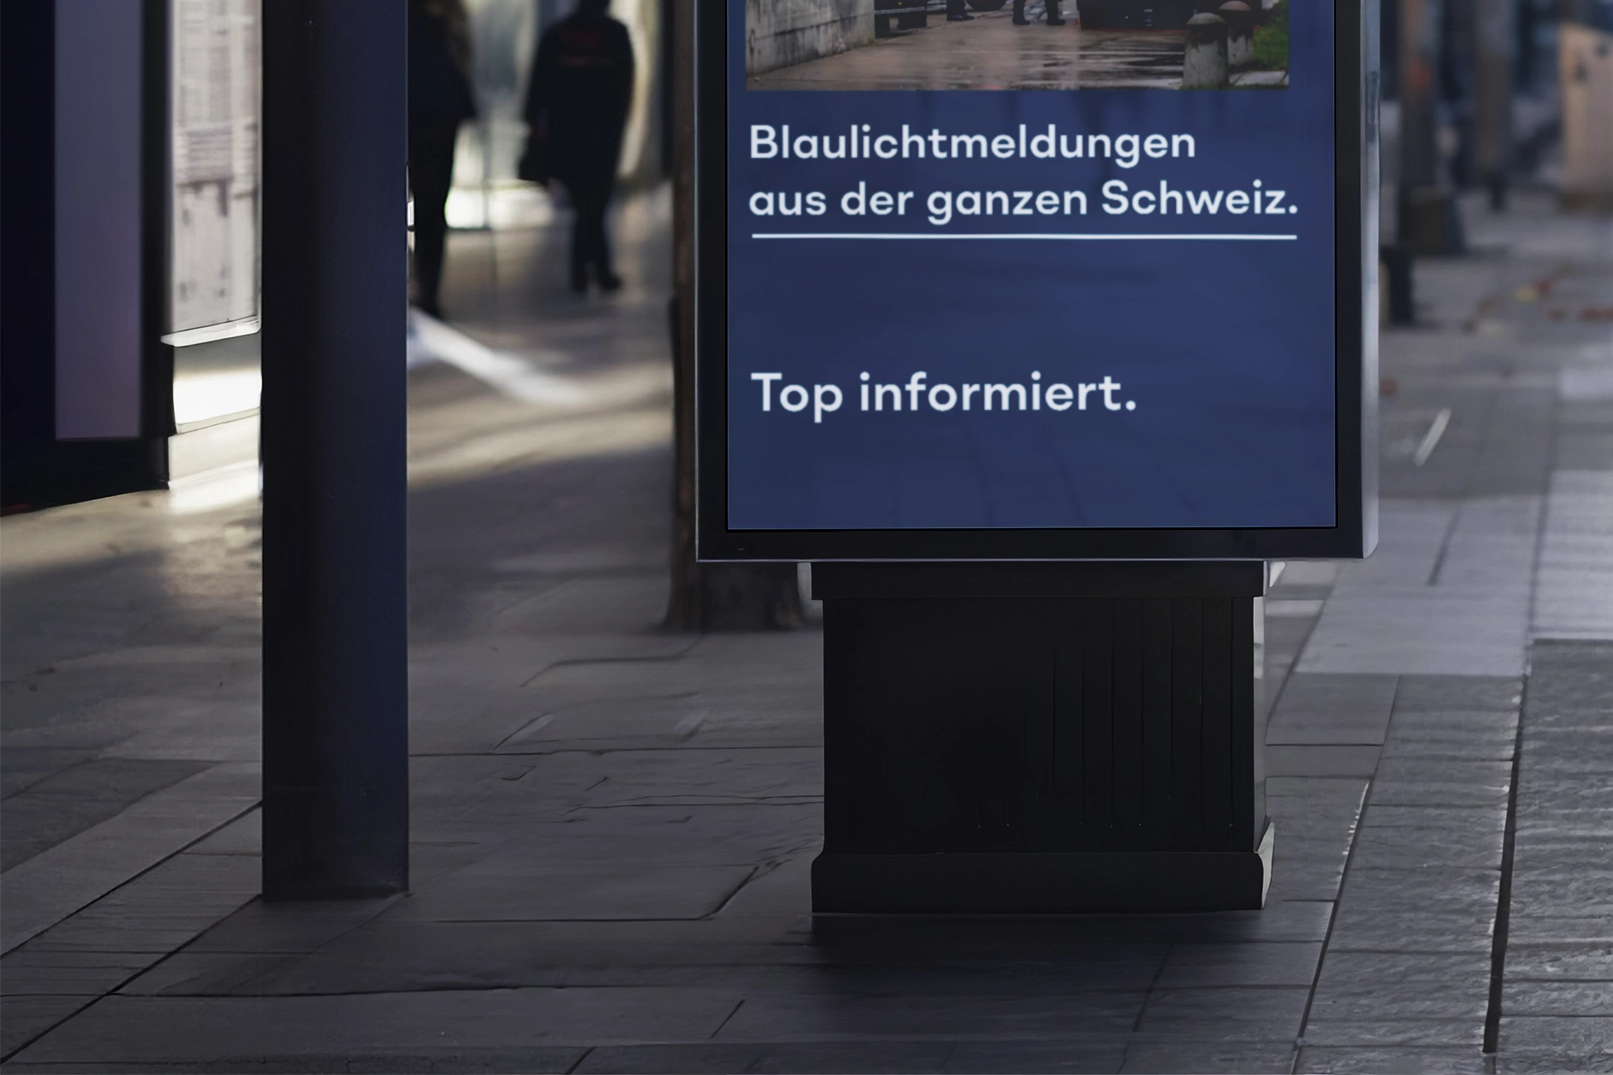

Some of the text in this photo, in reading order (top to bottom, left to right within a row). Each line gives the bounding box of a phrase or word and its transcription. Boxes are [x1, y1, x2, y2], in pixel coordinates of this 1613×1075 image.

[750, 123, 1197, 169] Blaulichtmeldungen
[749, 178, 1299, 226] aus der ganzen Schweiz.
[750, 370, 1137, 424] Top informiert.
